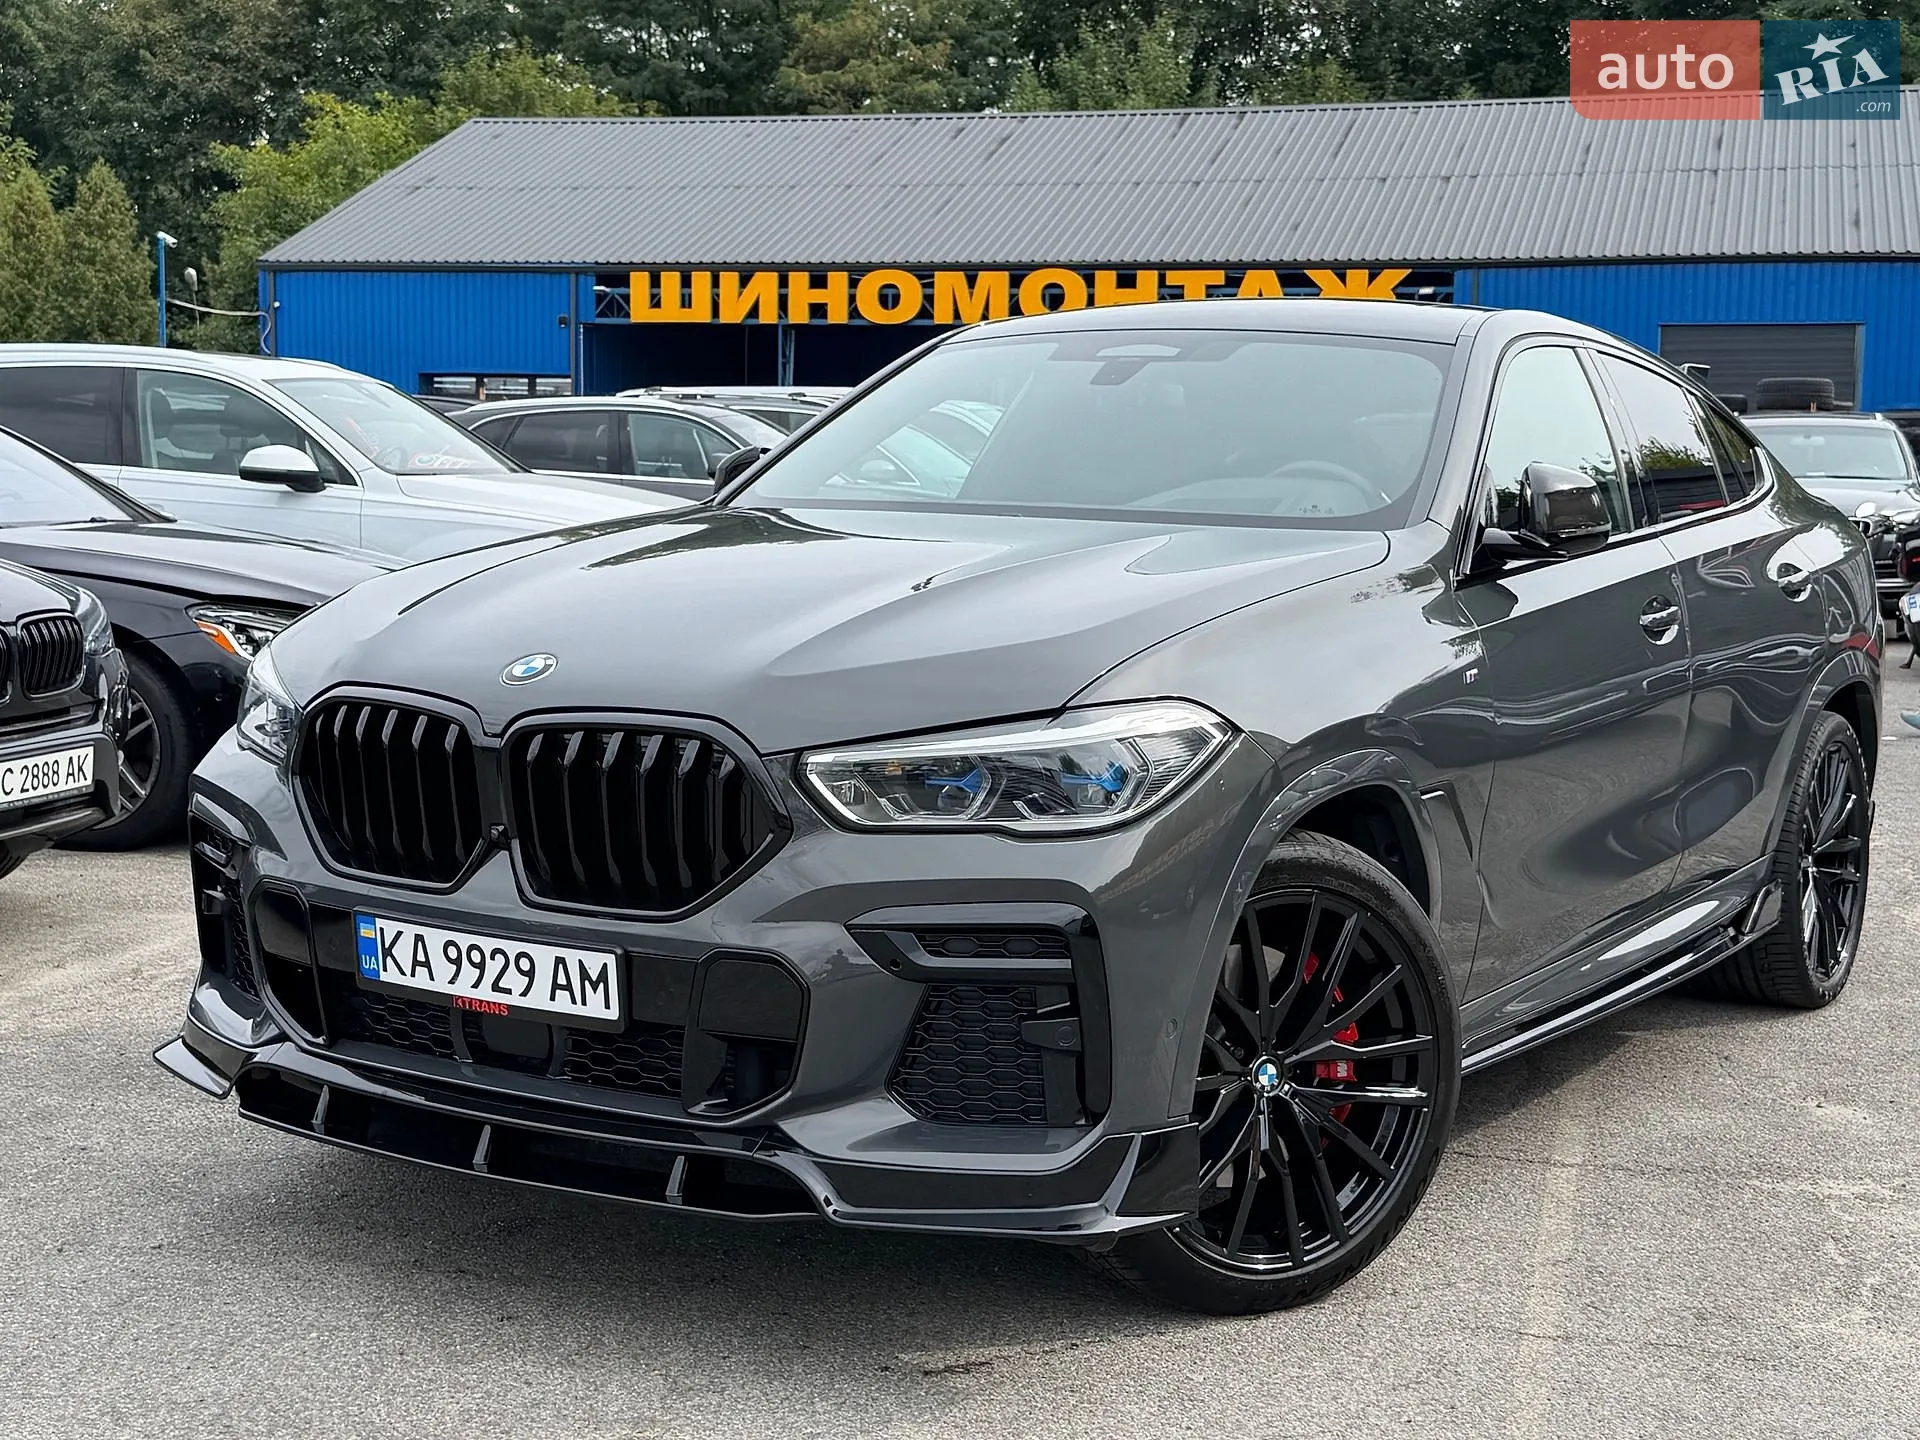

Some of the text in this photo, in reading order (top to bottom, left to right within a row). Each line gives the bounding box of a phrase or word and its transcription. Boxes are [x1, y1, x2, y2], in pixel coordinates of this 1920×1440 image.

[20, 759, 60, 794] 2888
[65, 753, 89, 786] AK
[362, 954, 378, 971] UA
[379, 926, 611, 1011] KA 9929 AM
